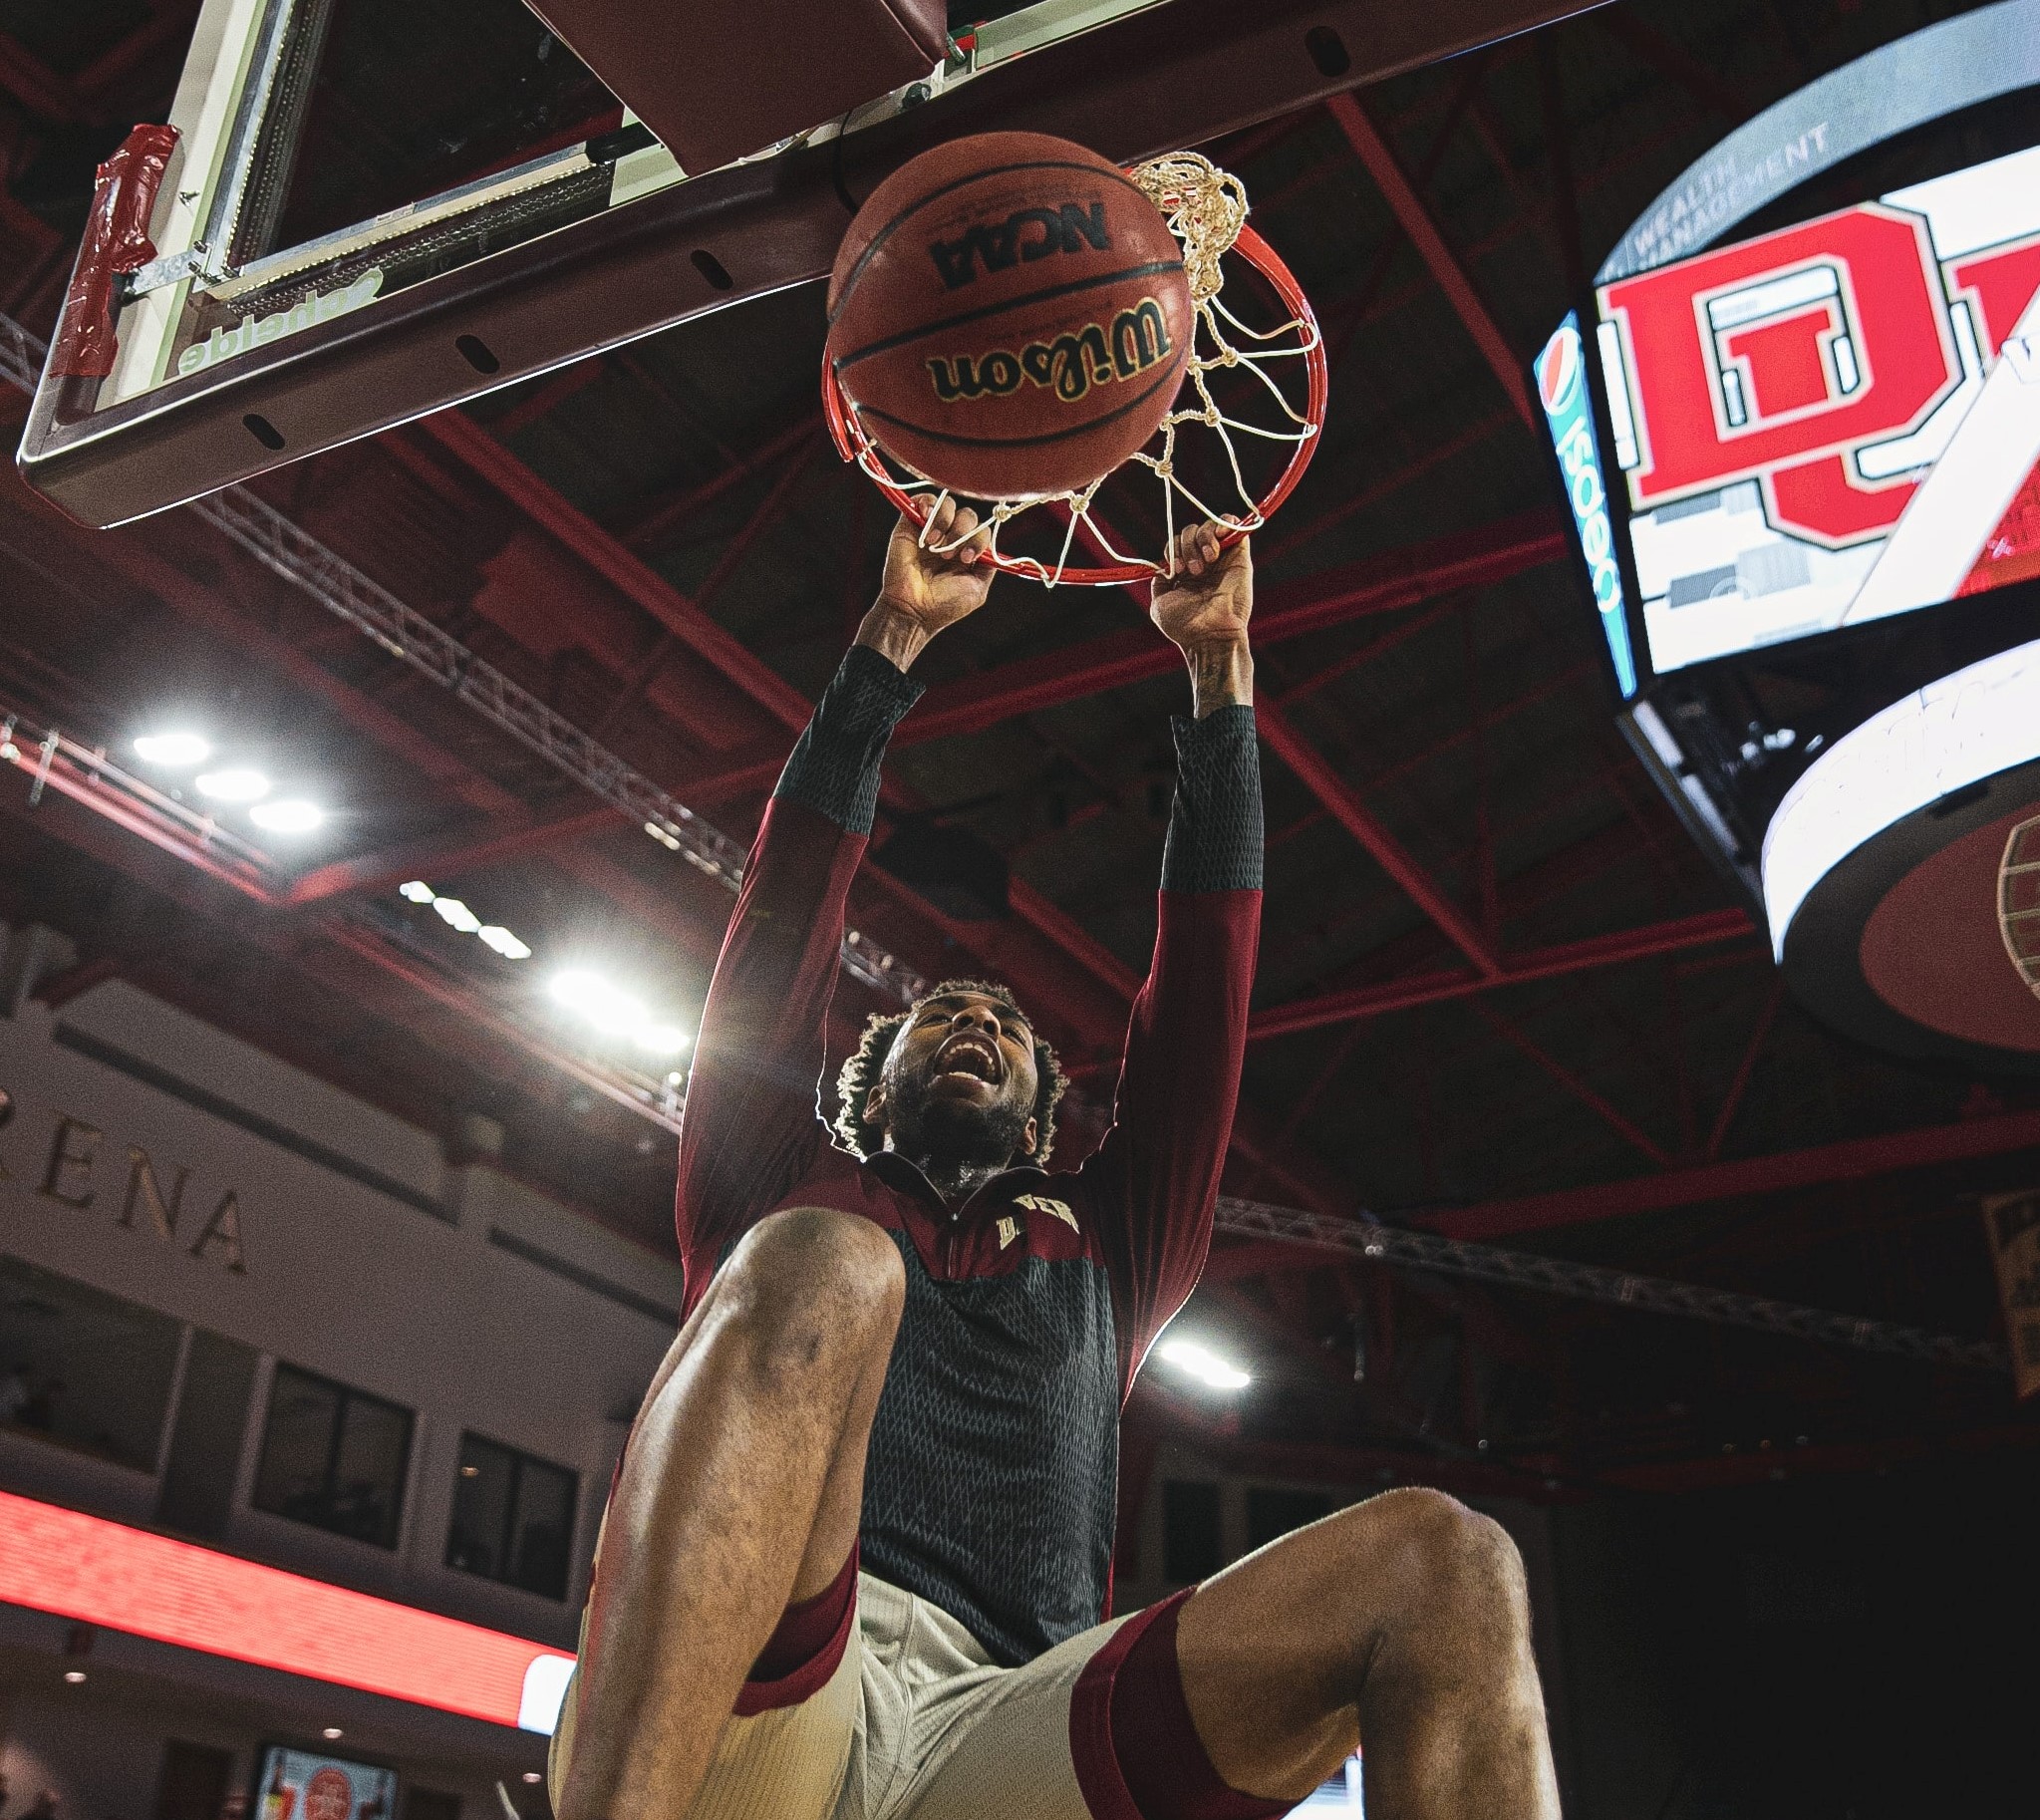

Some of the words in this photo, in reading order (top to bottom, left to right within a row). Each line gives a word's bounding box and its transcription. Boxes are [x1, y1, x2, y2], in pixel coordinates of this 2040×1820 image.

[929, 202, 1109, 290] NCAA
[1633, 153, 1738, 258] WEALTH
[926, 297, 1172, 402] Wilson
[1555, 415, 1621, 614] pepsi
